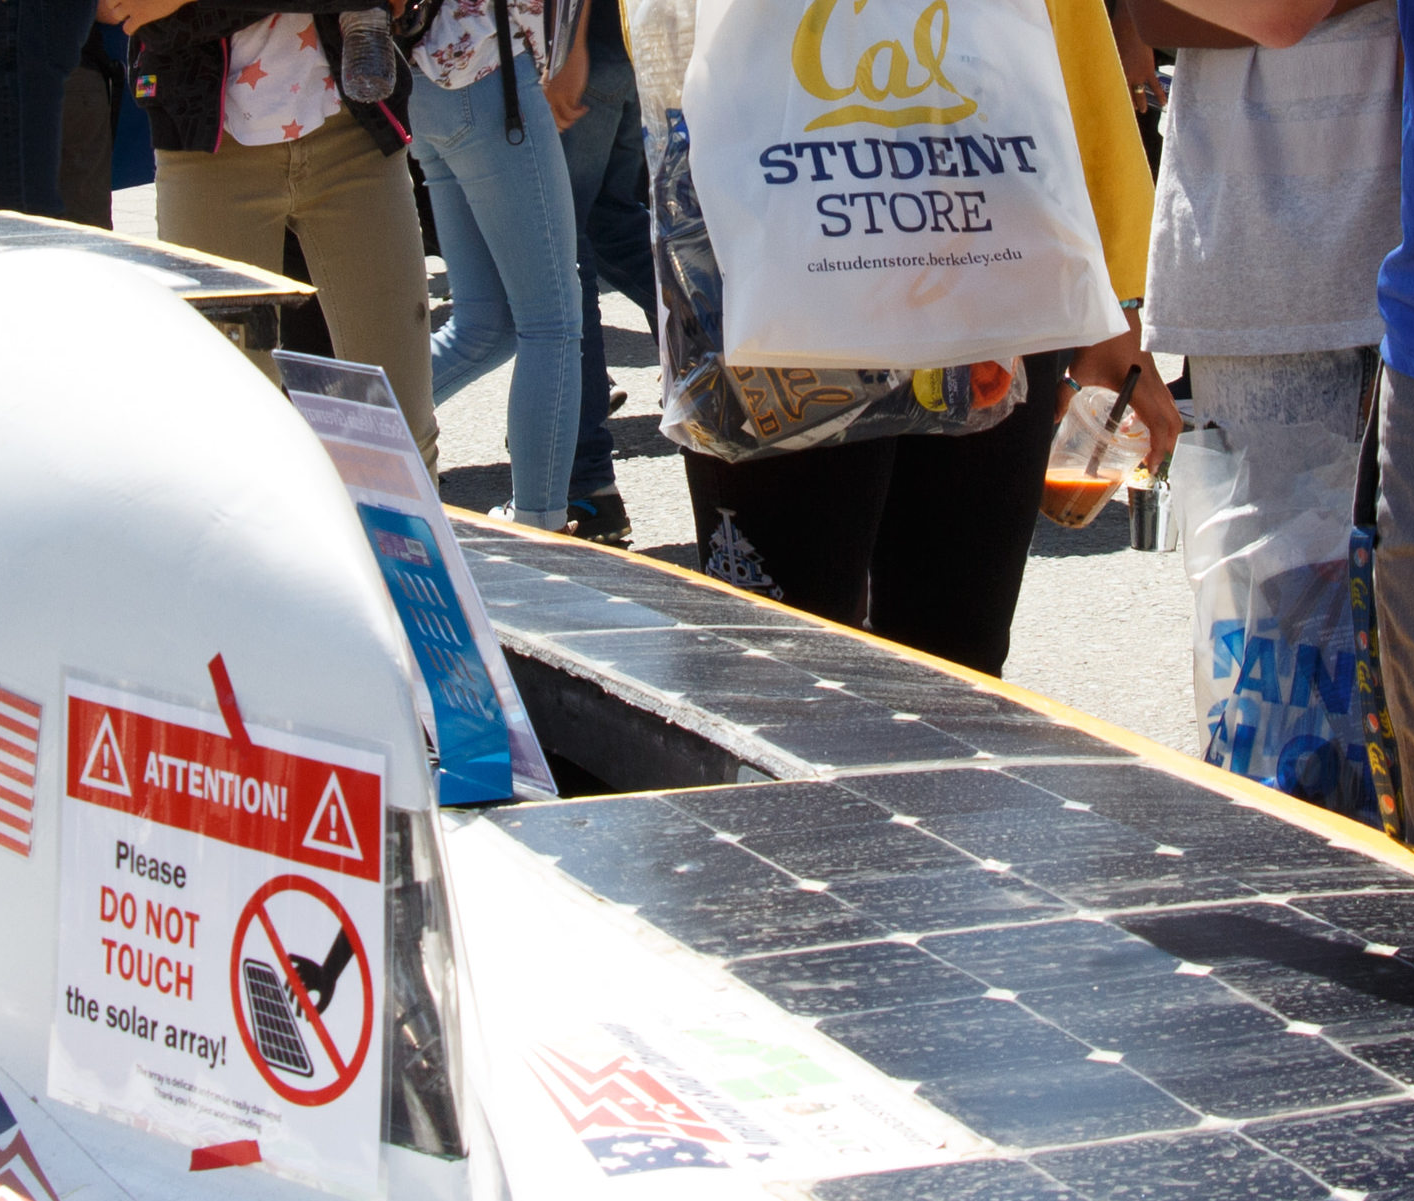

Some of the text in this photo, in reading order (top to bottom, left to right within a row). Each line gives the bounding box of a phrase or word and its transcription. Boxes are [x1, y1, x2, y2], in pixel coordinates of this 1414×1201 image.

[758, 135, 1038, 186] STUDENT
[815, 190, 994, 238] STORE
[806, 246, 1024, 273] calstudentstore.berkeley.edu
[142, 750, 289, 821] ATTENTION!
[114, 840, 188, 891] Please
[99, 885, 201, 950] DO NOT
[100, 938, 195, 1001] TOUCH
[65, 985, 228, 1069] the solar array!
